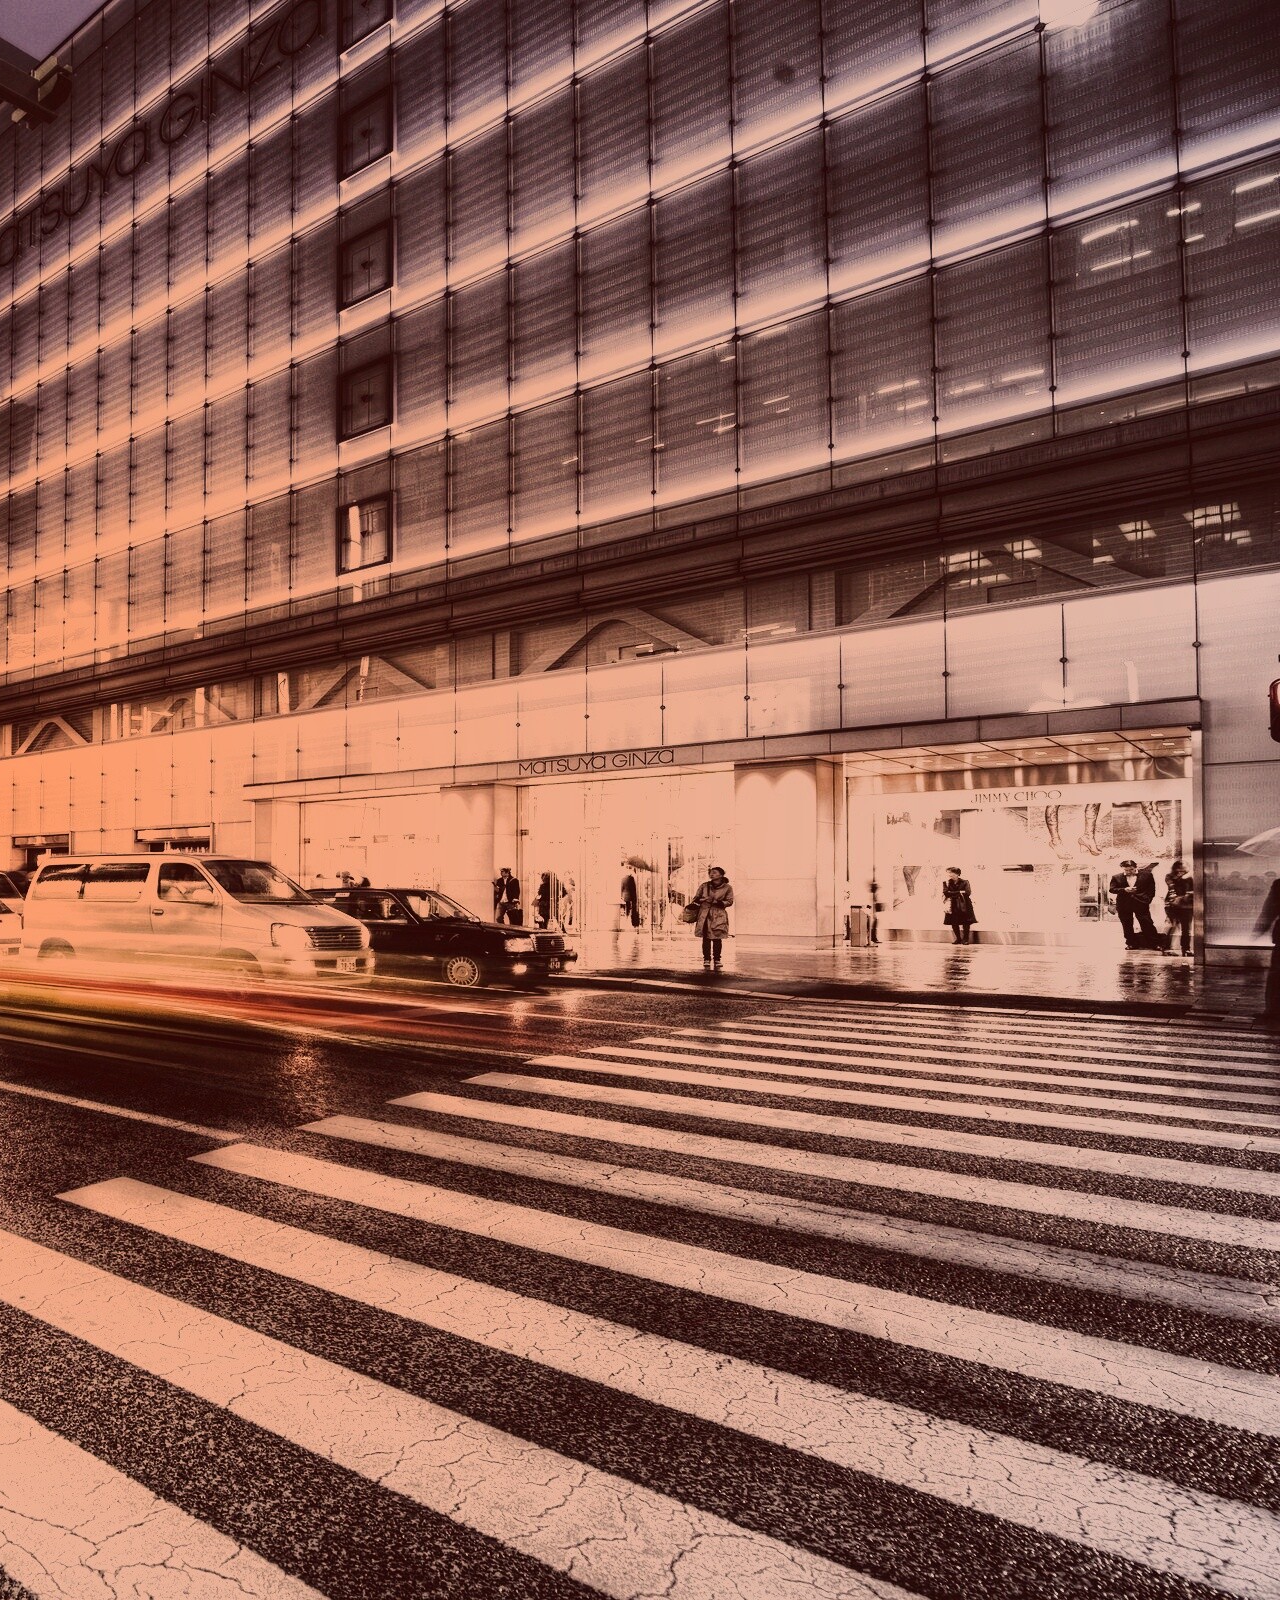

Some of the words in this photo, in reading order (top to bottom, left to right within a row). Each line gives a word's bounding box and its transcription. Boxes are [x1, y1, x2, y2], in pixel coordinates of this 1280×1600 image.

[612, 749, 674, 768] GINZA
[970, 792, 1011, 804] JIMMY
[1013, 789, 1062, 801] CHOO
